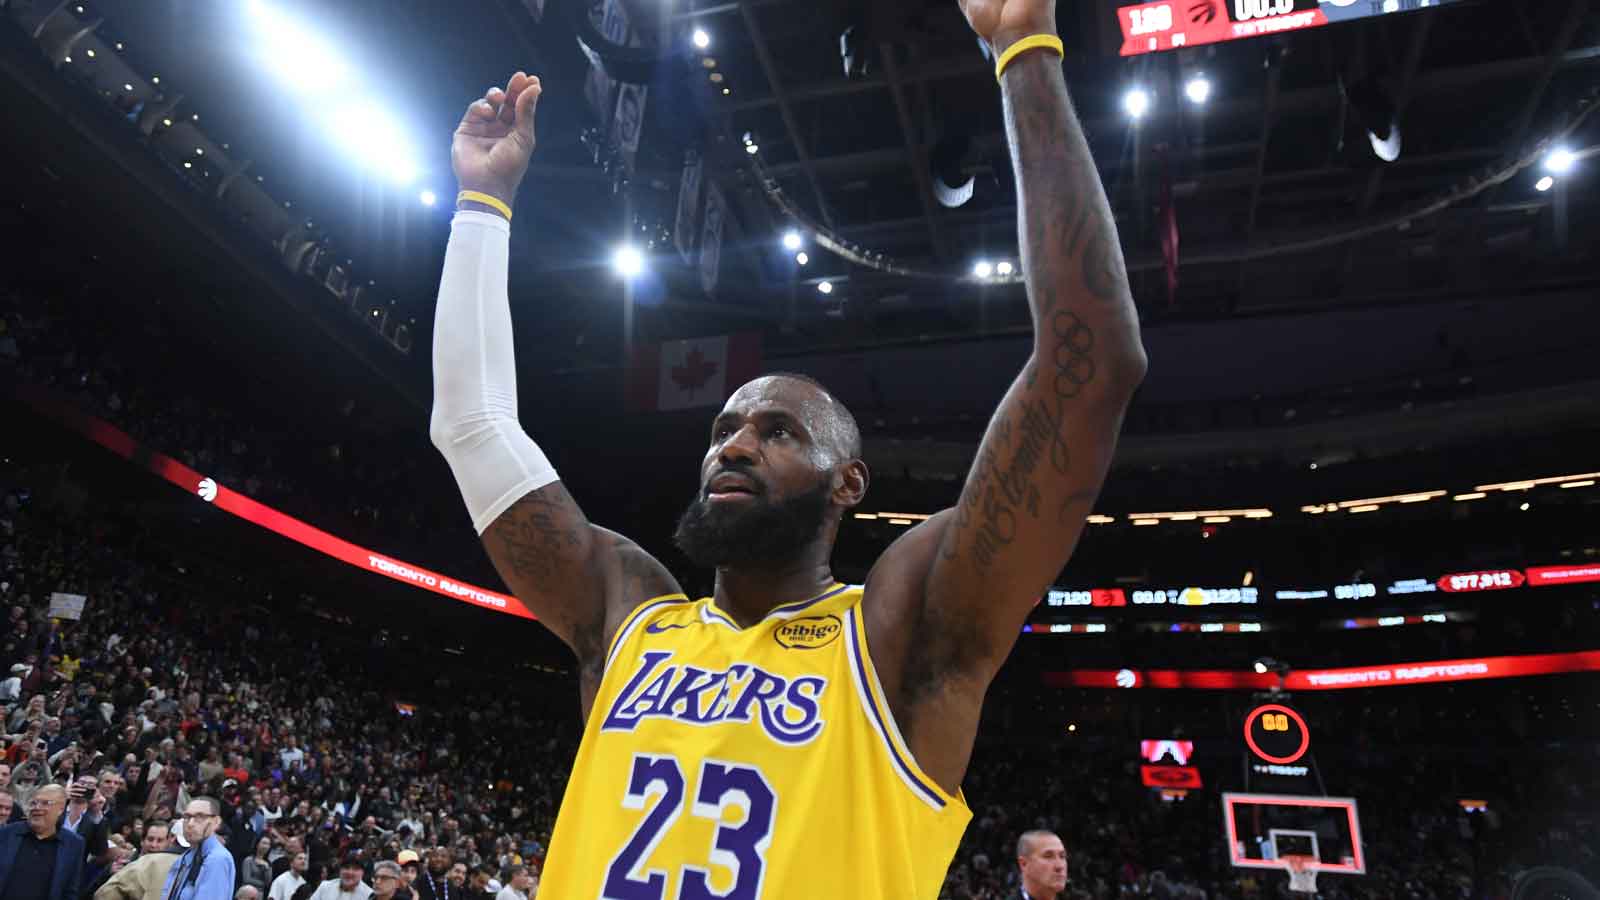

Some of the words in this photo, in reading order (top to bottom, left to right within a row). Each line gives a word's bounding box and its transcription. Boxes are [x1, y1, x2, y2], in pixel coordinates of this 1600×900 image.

[368, 556, 436, 587] TORONTO
[439, 578, 507, 608] RAPTORS
[781, 624, 839, 639] bibigo
[600, 651, 827, 747] LAKERS
[1307, 670, 1391, 686] TORONTO
[1395, 663, 1488, 679] RAPTORS
[600, 752, 778, 900] 23
